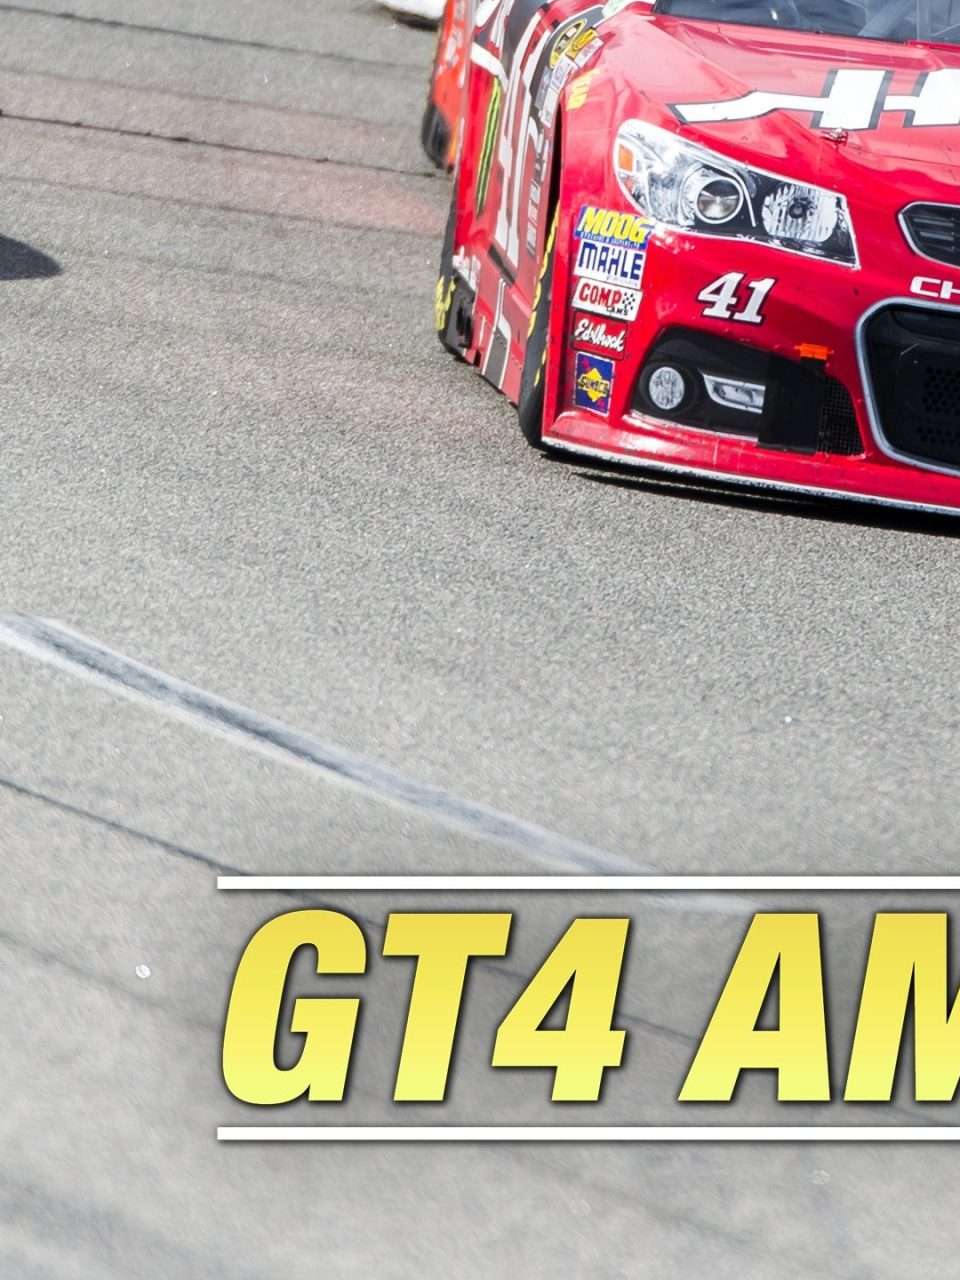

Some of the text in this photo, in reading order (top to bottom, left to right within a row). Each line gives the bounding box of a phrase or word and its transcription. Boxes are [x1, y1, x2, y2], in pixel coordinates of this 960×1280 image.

[579, 205, 652, 244] MOOG
[578, 240, 644, 282] MAHLE
[578, 282, 623, 309] COMP
[698, 271, 778, 324] 41
